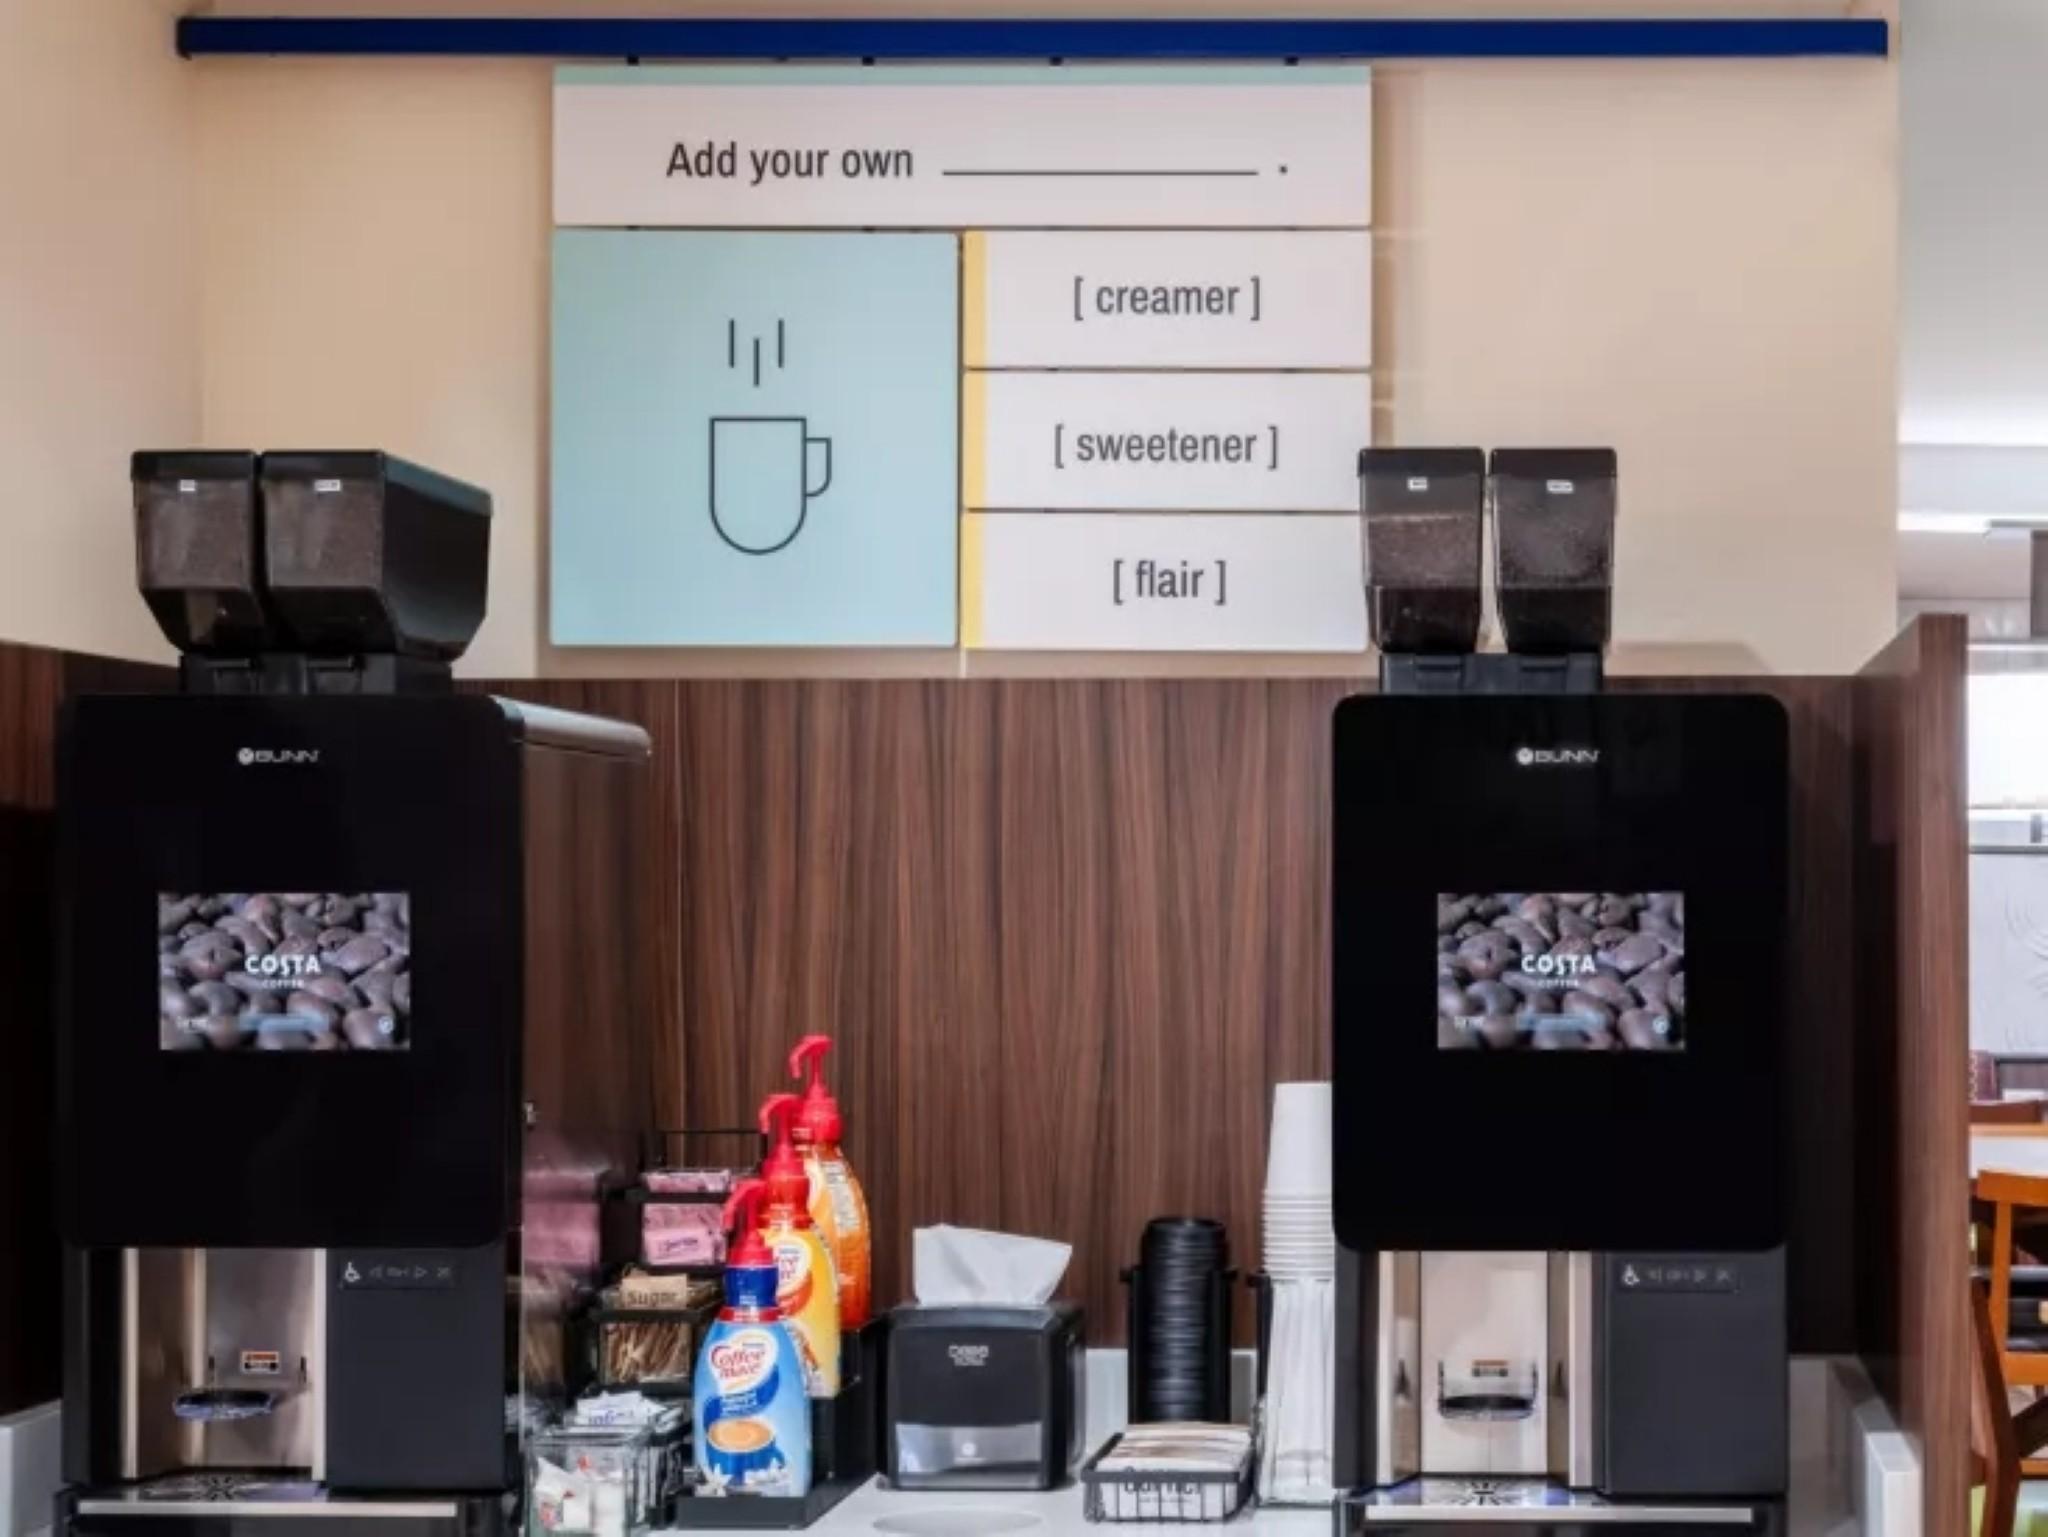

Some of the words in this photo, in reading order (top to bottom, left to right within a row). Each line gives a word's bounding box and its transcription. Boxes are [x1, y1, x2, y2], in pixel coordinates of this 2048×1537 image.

[666, 140, 738, 179] Add
[749, 149, 830, 187] your
[841, 149, 913, 179] own
[1096, 286, 1240, 316] creamer
[1077, 429, 1257, 463] sweetener
[1135, 559, 1204, 598] flair
[255, 750, 319, 763] BUNN
[1534, 750, 1600, 763] BUNN
[245, 954, 321, 974] COSTA
[1521, 954, 1596, 974] COSTA
[627, 1289, 680, 1308] Sugar
[711, 1344, 766, 1368] Coffee
